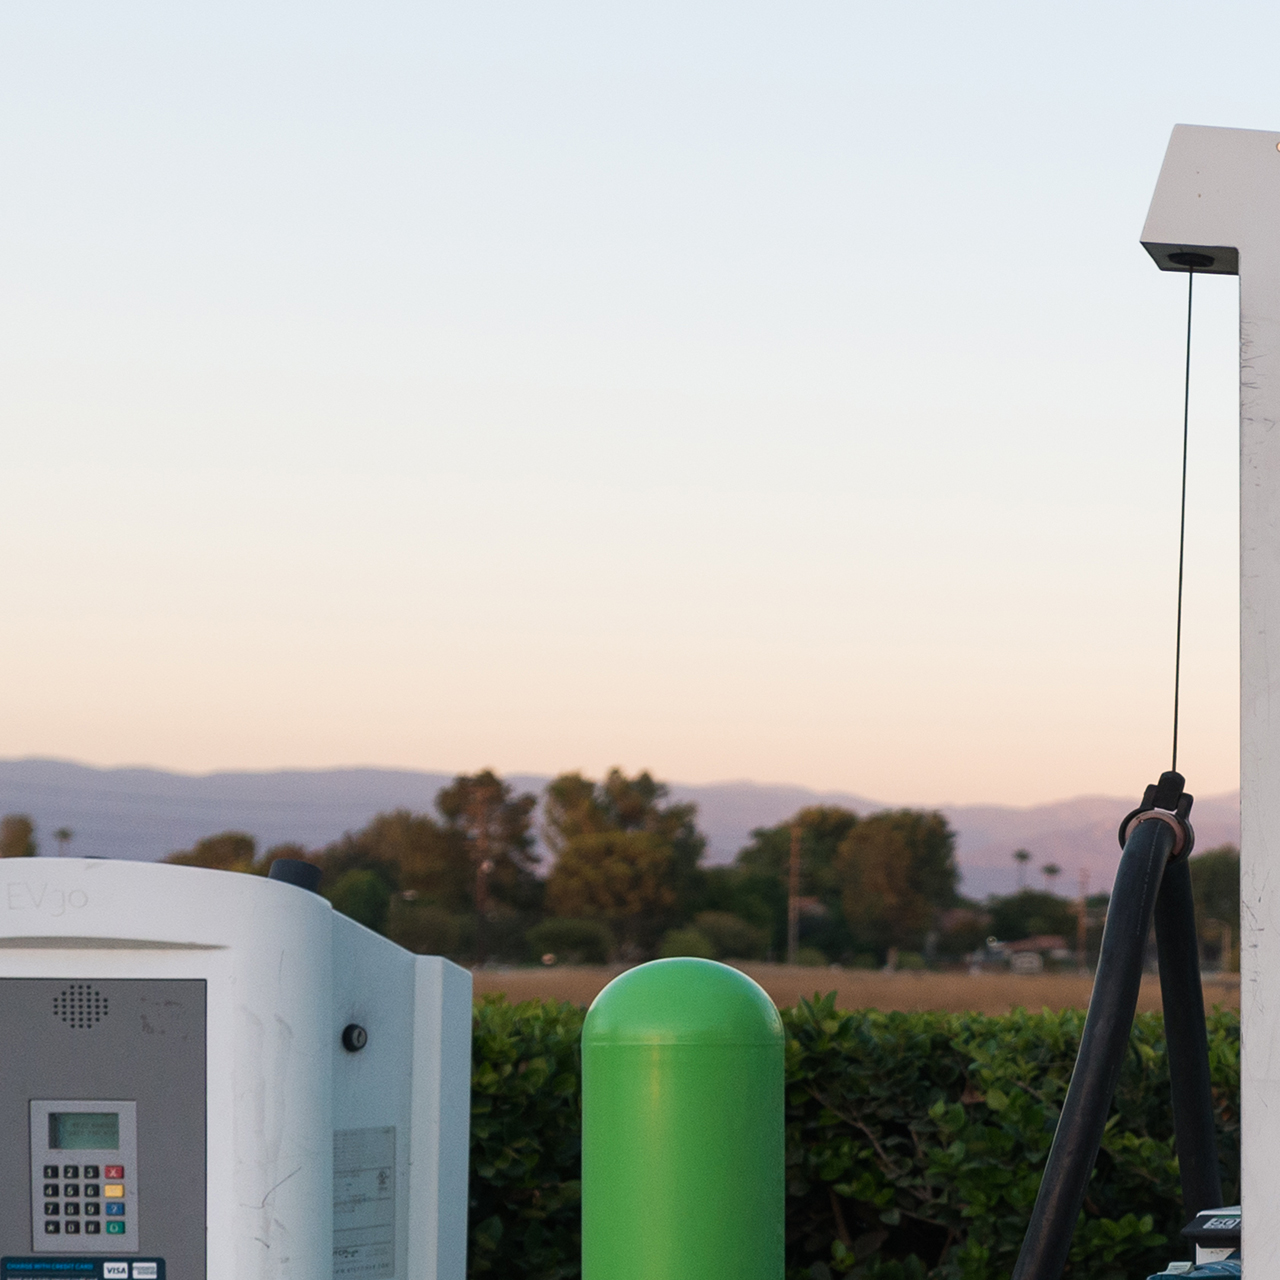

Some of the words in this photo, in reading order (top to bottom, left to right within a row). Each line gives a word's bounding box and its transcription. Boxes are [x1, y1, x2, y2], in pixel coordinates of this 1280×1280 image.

[67, 1186, 74, 1196] 5
[87, 1186, 94, 1196] 6
[51, 1262, 74, 1270] CREDIT
[75, 1262, 94, 1270] CARD
